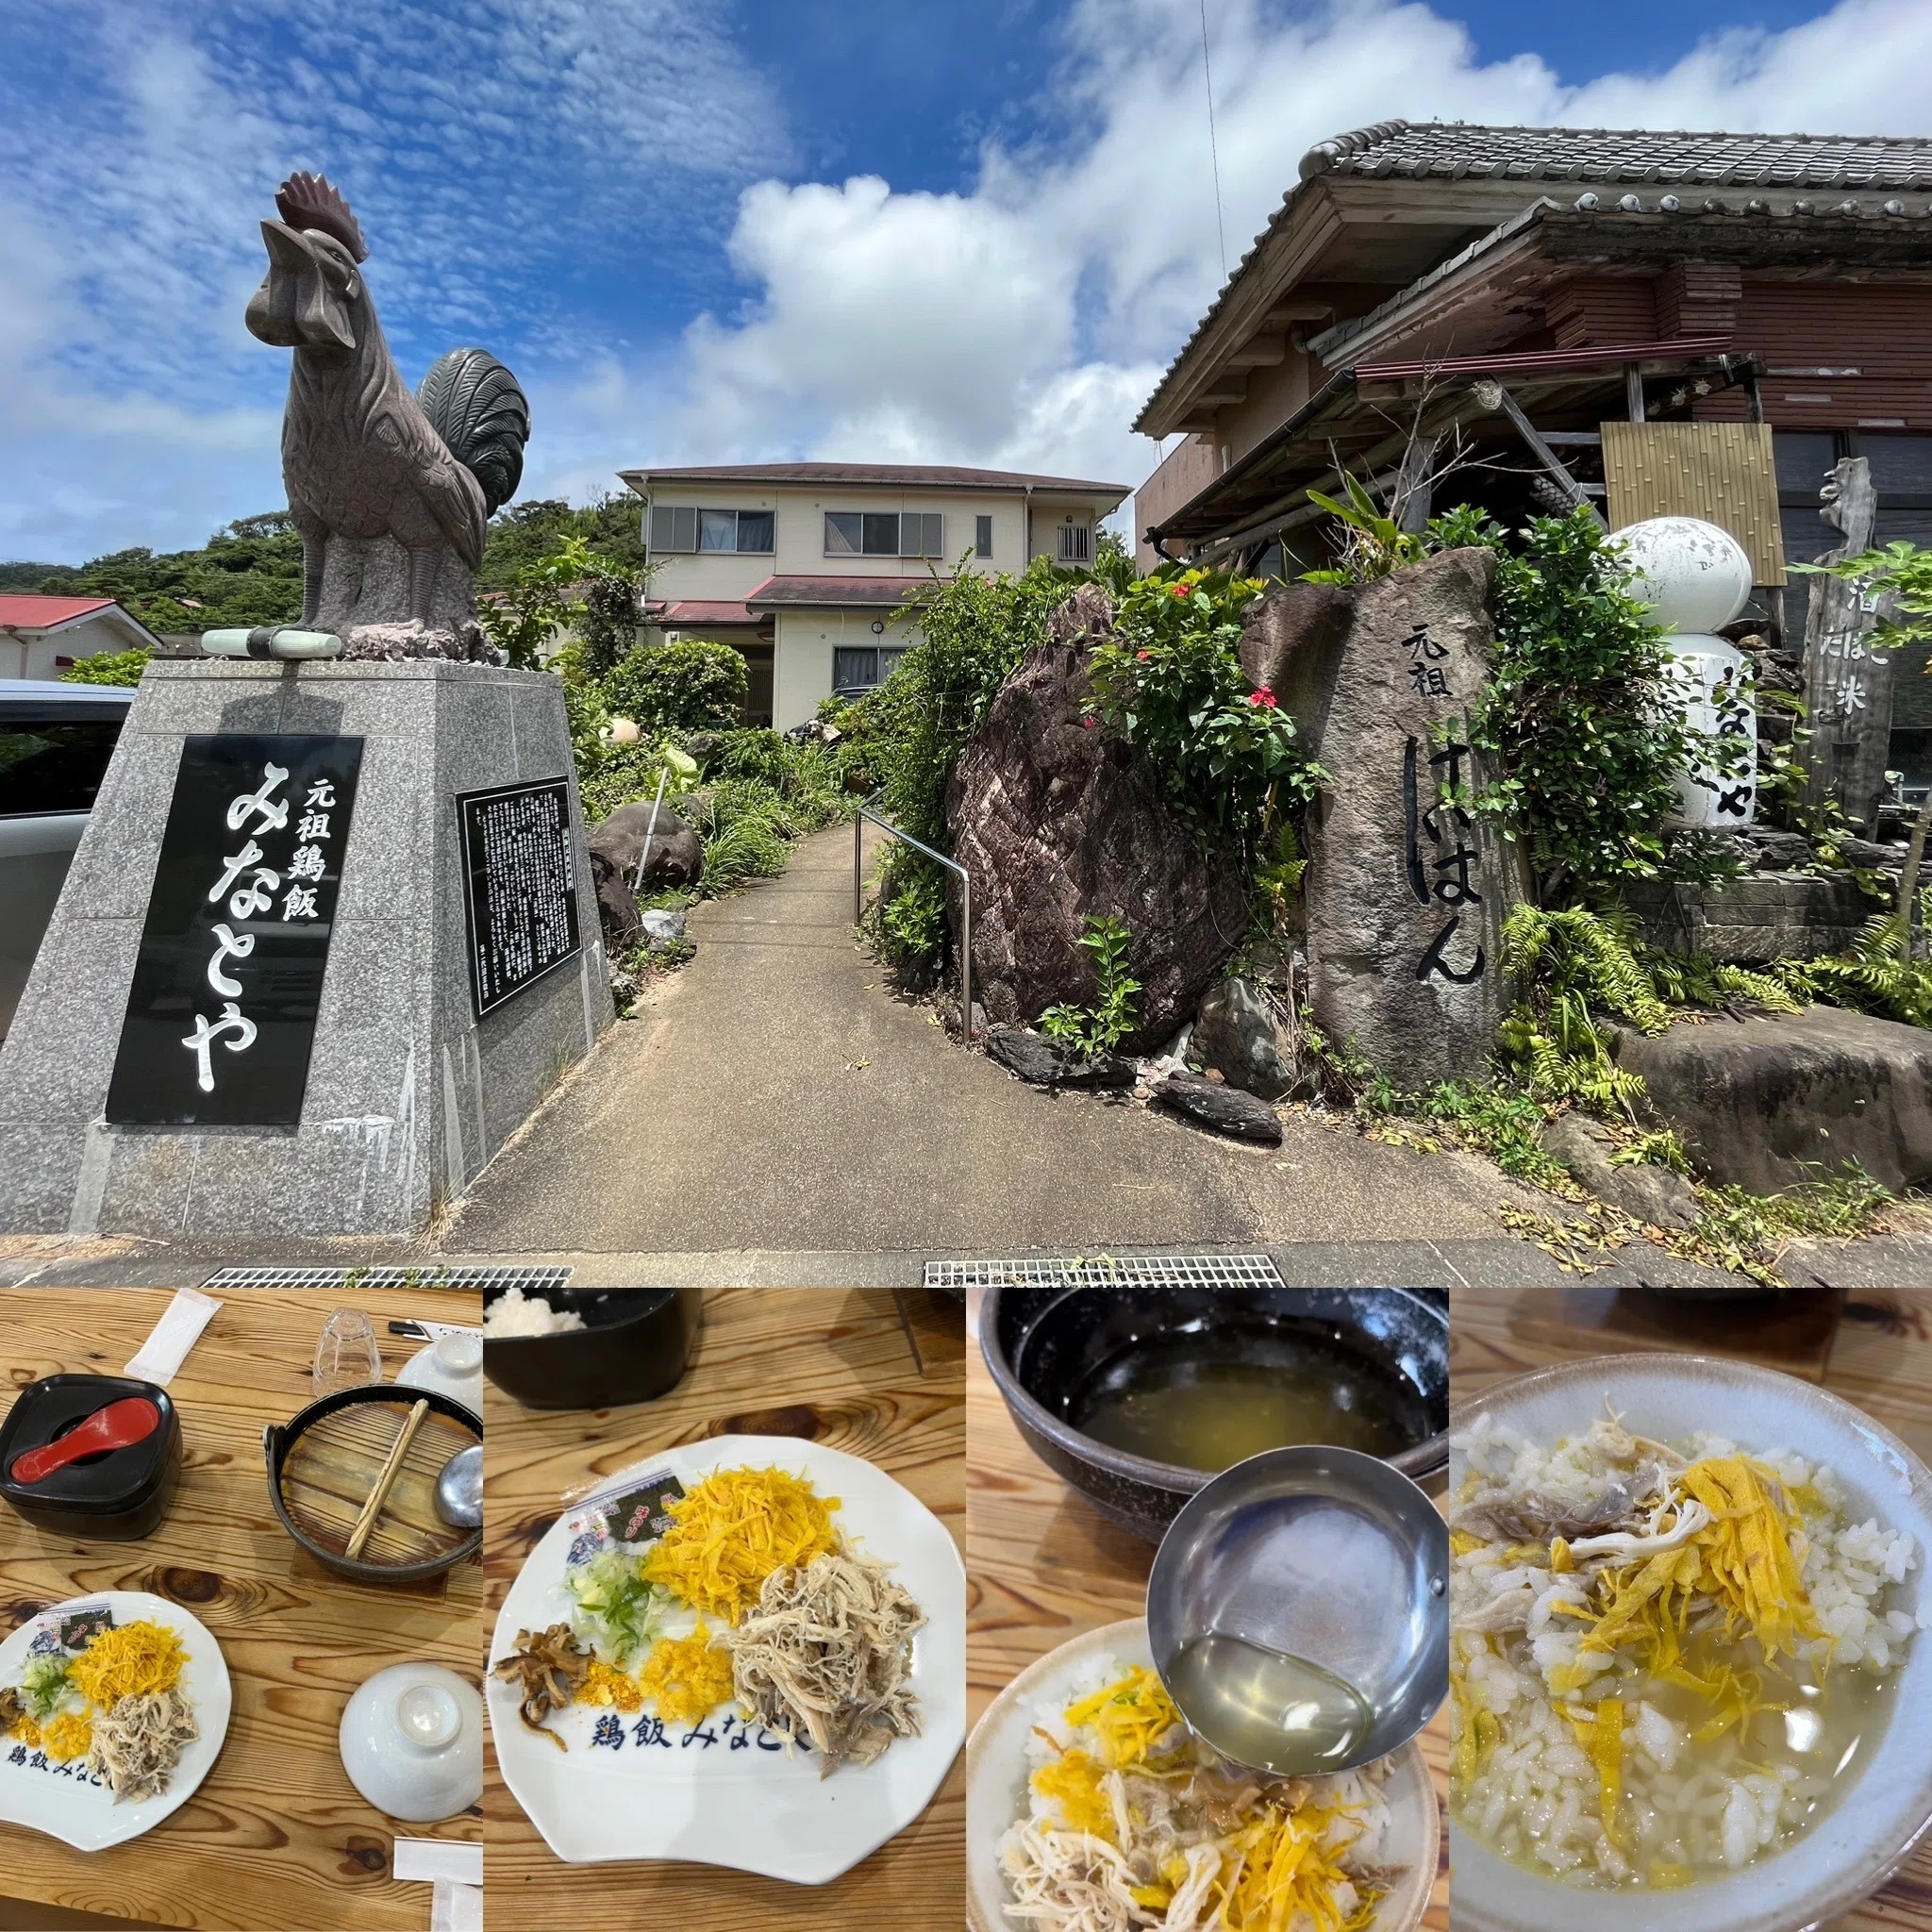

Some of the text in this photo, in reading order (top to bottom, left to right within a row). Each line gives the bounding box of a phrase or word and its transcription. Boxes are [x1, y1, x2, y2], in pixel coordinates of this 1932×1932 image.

[1402, 624, 1453, 697] 元祖
[1836, 675, 1866, 714] 米
[282, 778, 337, 922] 元祖鶏飯
[181, 761, 289, 1092] みなとや
